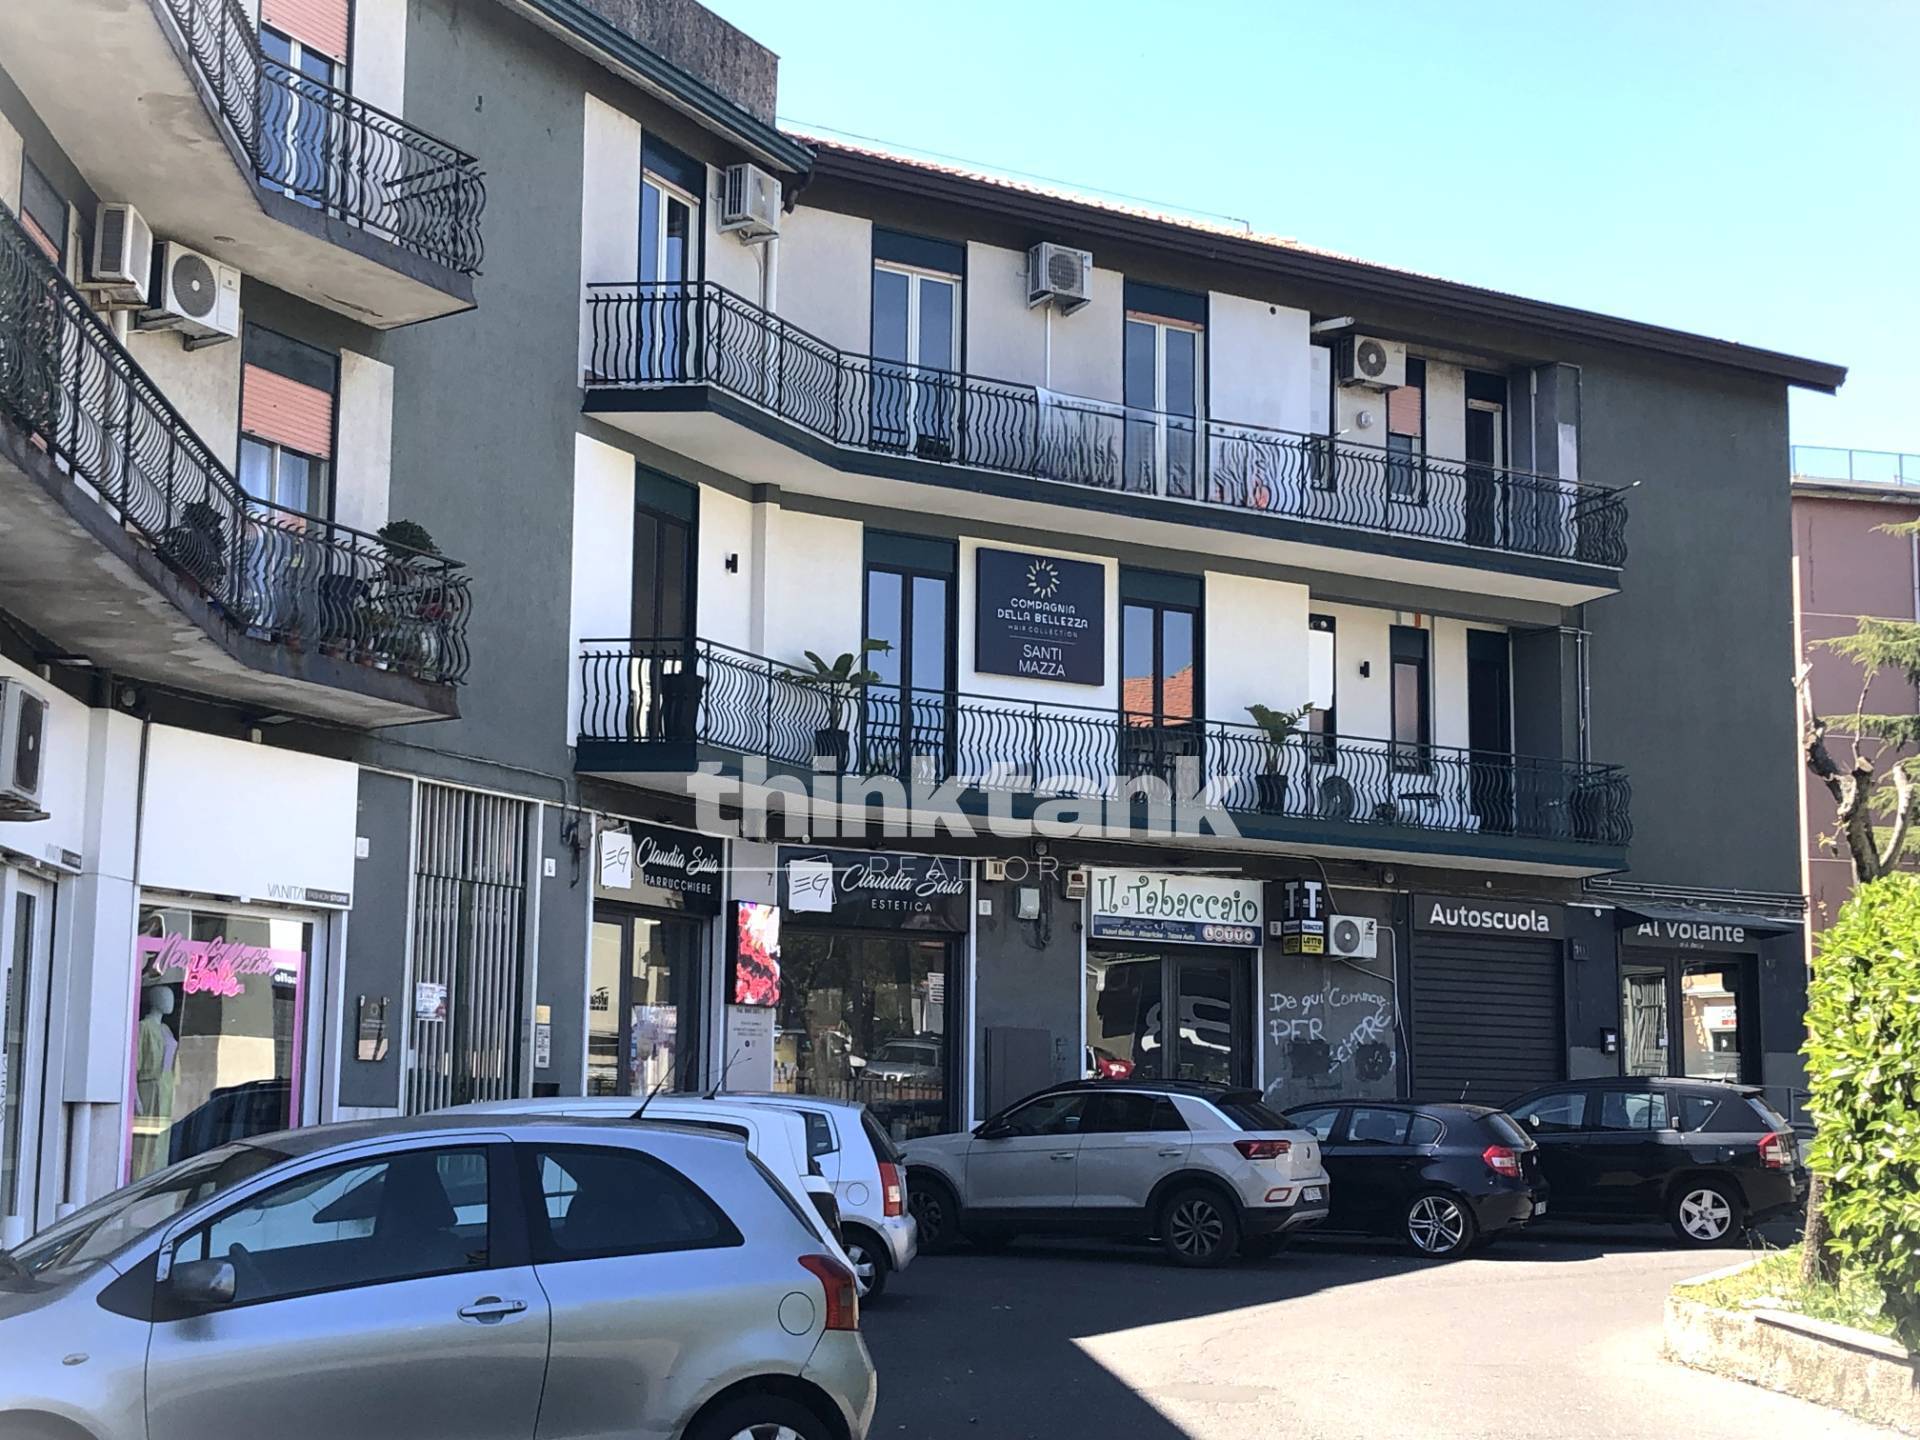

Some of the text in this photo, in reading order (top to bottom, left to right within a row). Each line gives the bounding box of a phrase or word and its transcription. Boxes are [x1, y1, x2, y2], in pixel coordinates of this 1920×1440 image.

[1010, 598, 1076, 614] COMPAGNIA
[997, 608, 1088, 629] DELLA BELLEZZA
[1028, 626, 1078, 638] COLLECTION
[1023, 644, 1062, 661] SANTI
[1019, 659, 1065, 677] MAZZA
[636, 836, 719, 876] Claudia Saia
[644, 874, 712, 894] PARRUCCHIERE
[767, 872, 773, 886] 7
[840, 864, 967, 897] Claudia Saia
[871, 899, 933, 913] ESTETICA
[1097, 875, 1258, 923] Il Tabaccaio
[1430, 903, 1550, 933] Autoscuola
[1205, 926, 1253, 942] LOTTO
[1637, 922, 1745, 943] Al Volante
[1269, 993, 1298, 1012] Da
